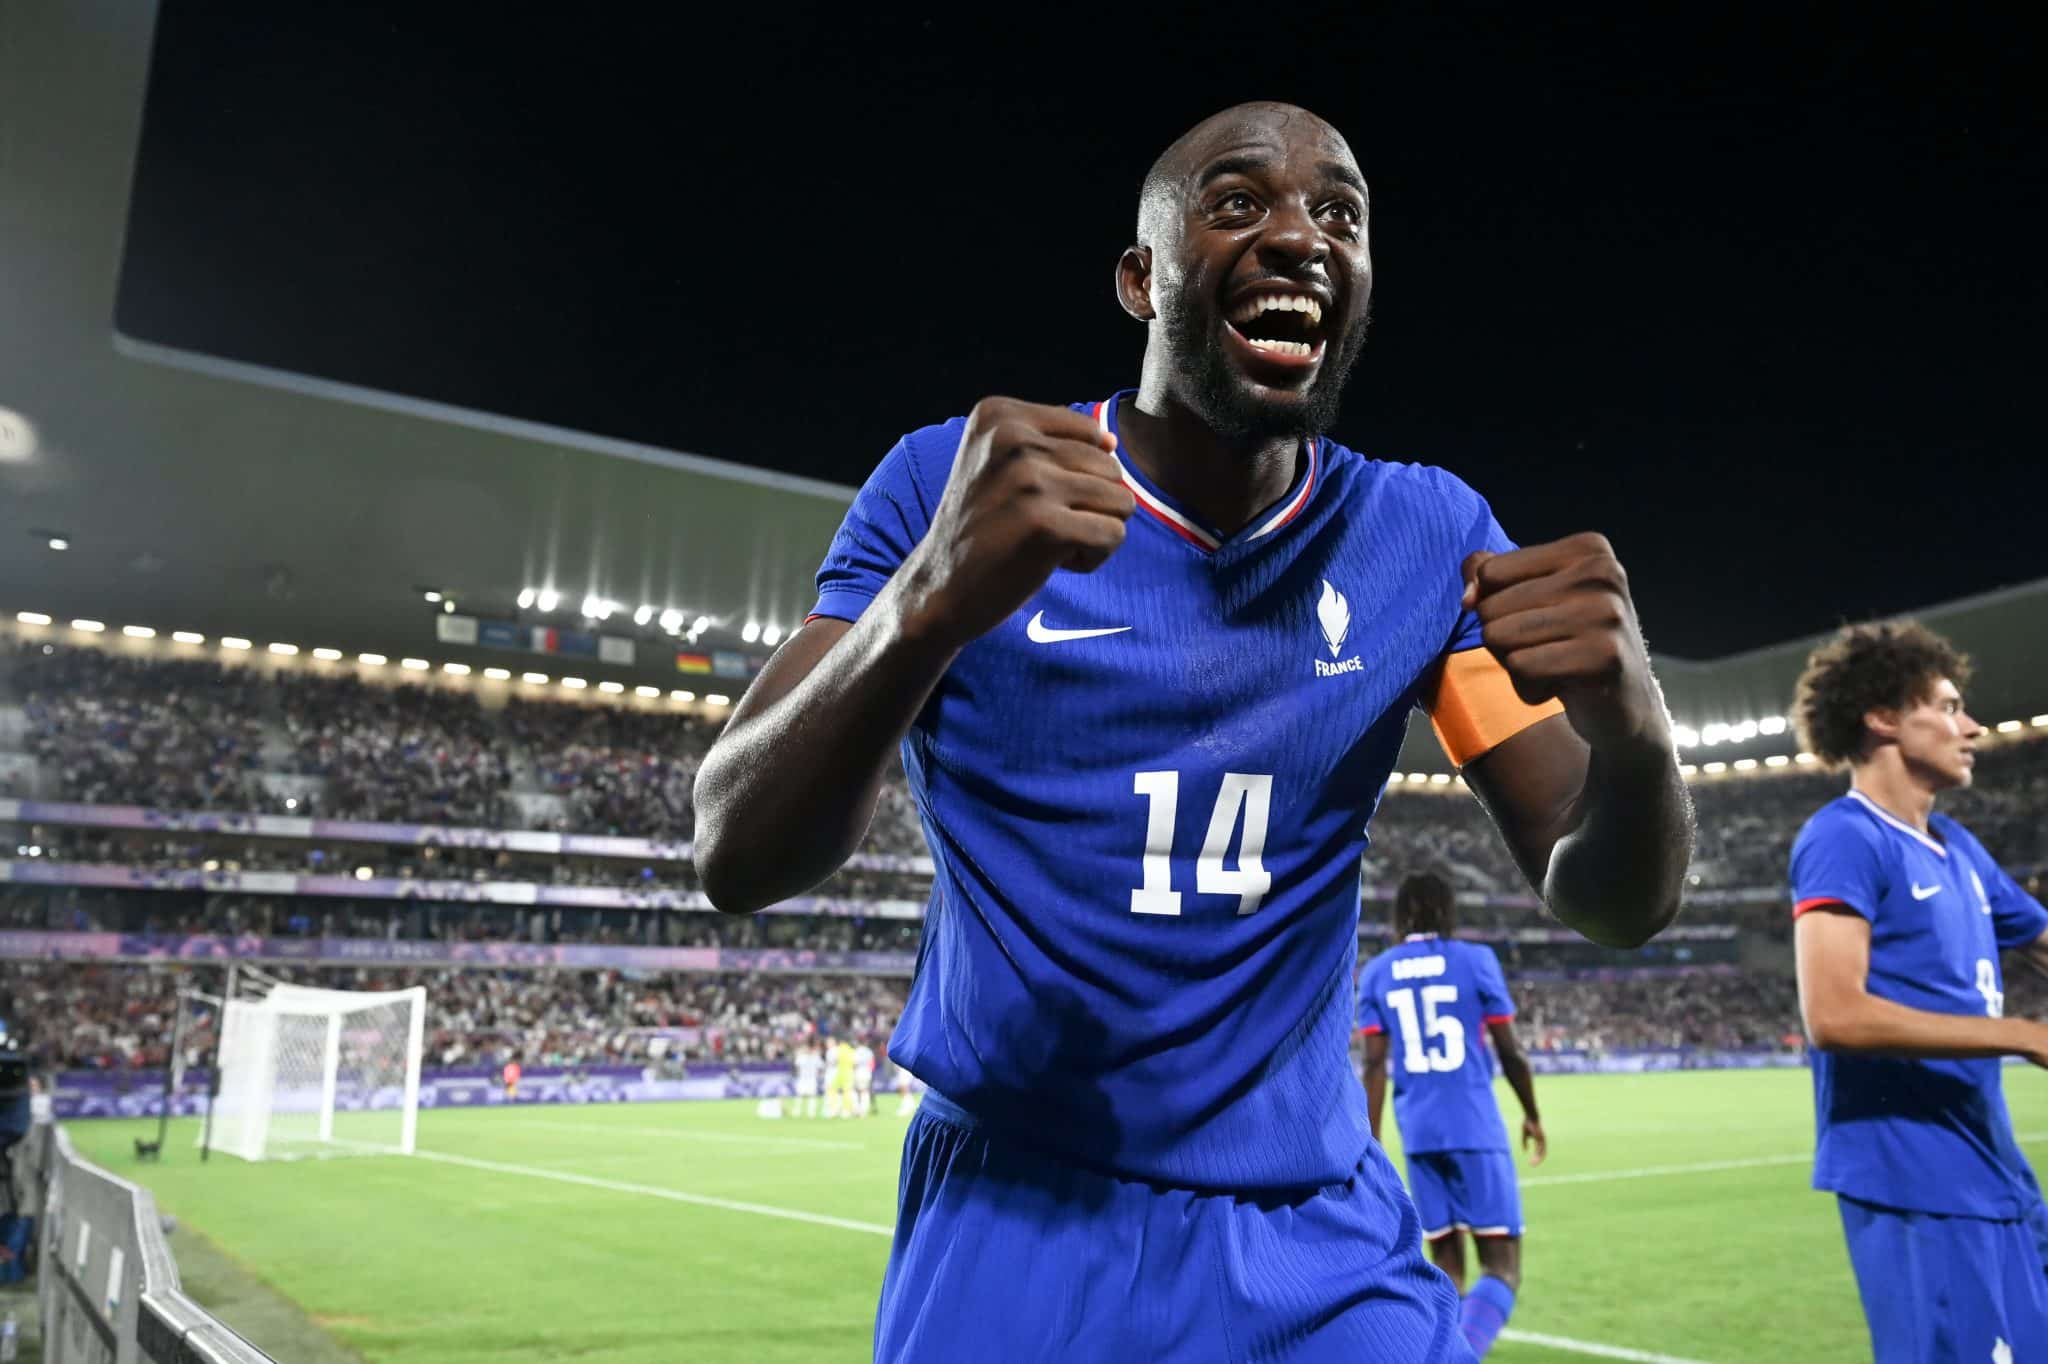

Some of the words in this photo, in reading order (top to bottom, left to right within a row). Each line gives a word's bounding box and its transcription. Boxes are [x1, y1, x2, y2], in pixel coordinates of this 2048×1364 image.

[1314, 655, 1364, 677] FRANCE
[1130, 770, 1273, 915] 14
[1386, 986, 1466, 1073] 15
